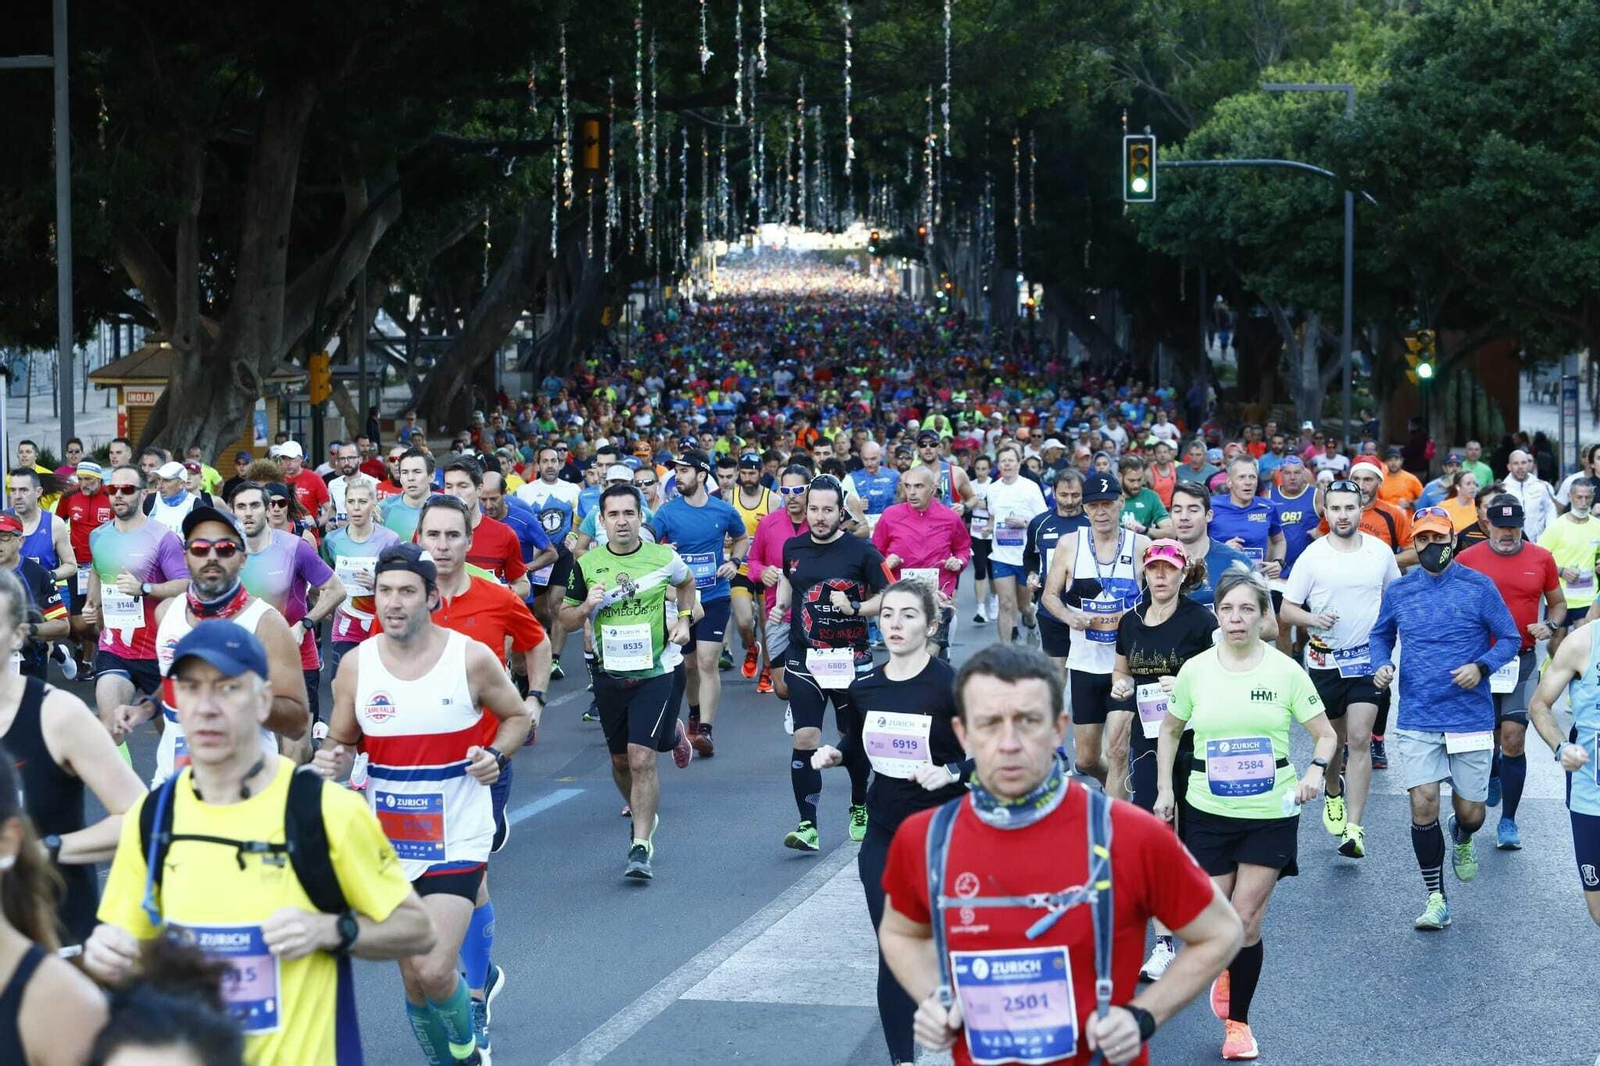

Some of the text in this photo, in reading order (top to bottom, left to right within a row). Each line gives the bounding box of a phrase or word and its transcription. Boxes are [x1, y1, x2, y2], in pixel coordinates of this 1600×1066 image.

[814, 604, 841, 613] ESQ
[622, 642, 643, 651] 8535
[827, 662, 847, 670] 6805
[1156, 703, 1168, 712] 68
[888, 719, 915, 728] ZURICH
[892, 739, 918, 750] 6919
[1231, 742, 1260, 750] ZURICH
[1237, 760, 1264, 771] 2584
[396, 798, 428, 806] ZURICH
[200, 932, 251, 947] ZURICH
[991, 960, 1042, 975] ZURICH
[1003, 993, 1049, 1011] 2501
